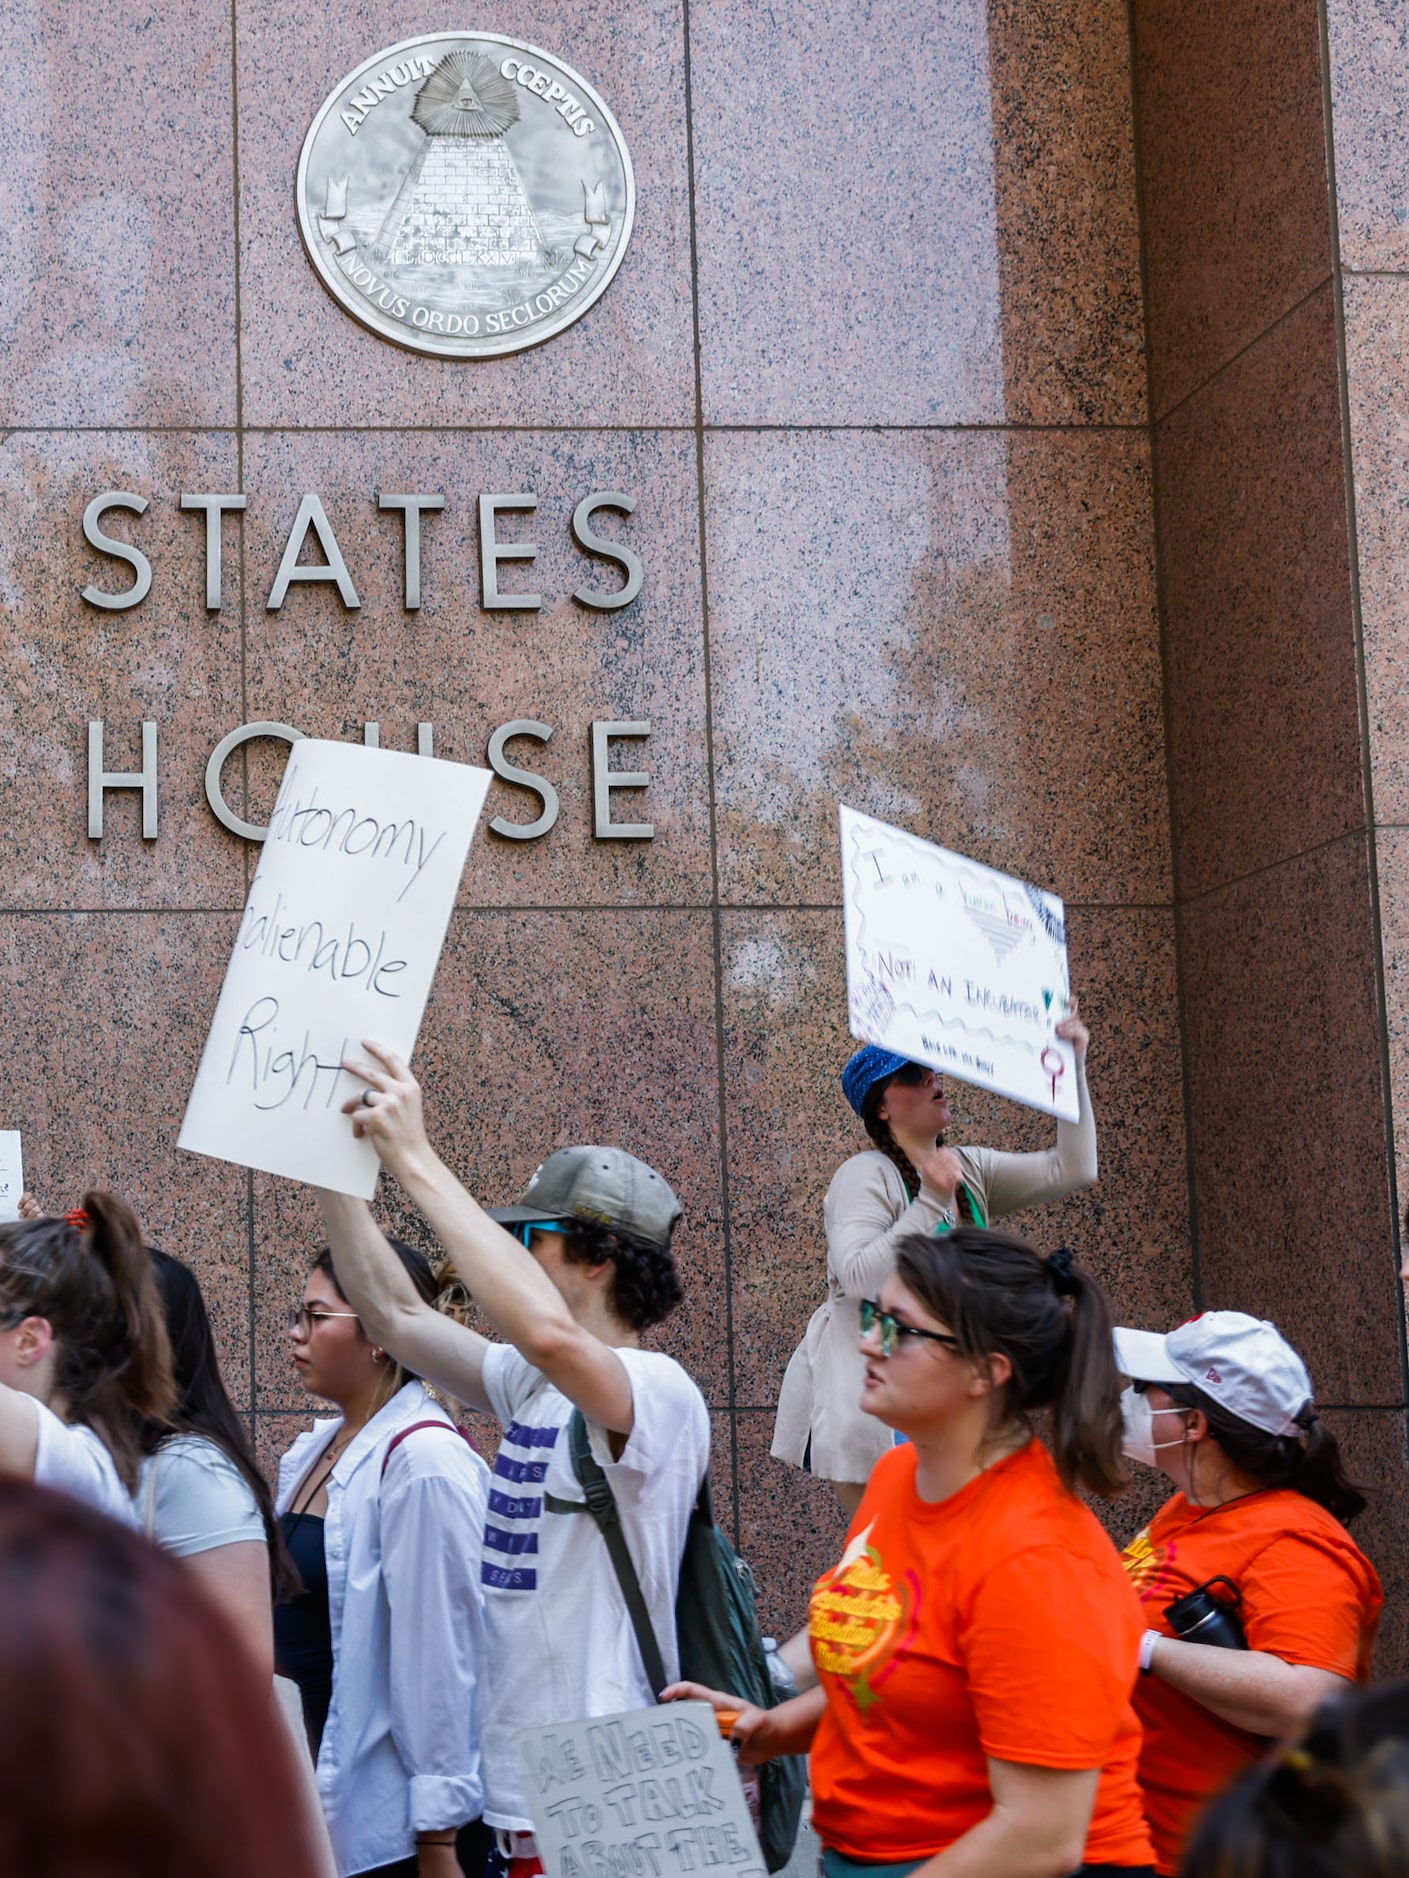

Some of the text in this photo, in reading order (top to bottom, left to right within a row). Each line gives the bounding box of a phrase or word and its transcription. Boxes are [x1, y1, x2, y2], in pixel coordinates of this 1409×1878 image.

[339, 54, 437, 136] ANNUIT
[341, 255, 595, 336] NOVUS ORDO SECLORUM
[80, 490, 645, 612] STATES
[88, 719, 655, 844] HOSE
[585, 1717, 710, 1783] NEED
[602, 1765, 726, 1828] TALK
[666, 1821, 753, 1872] THE
